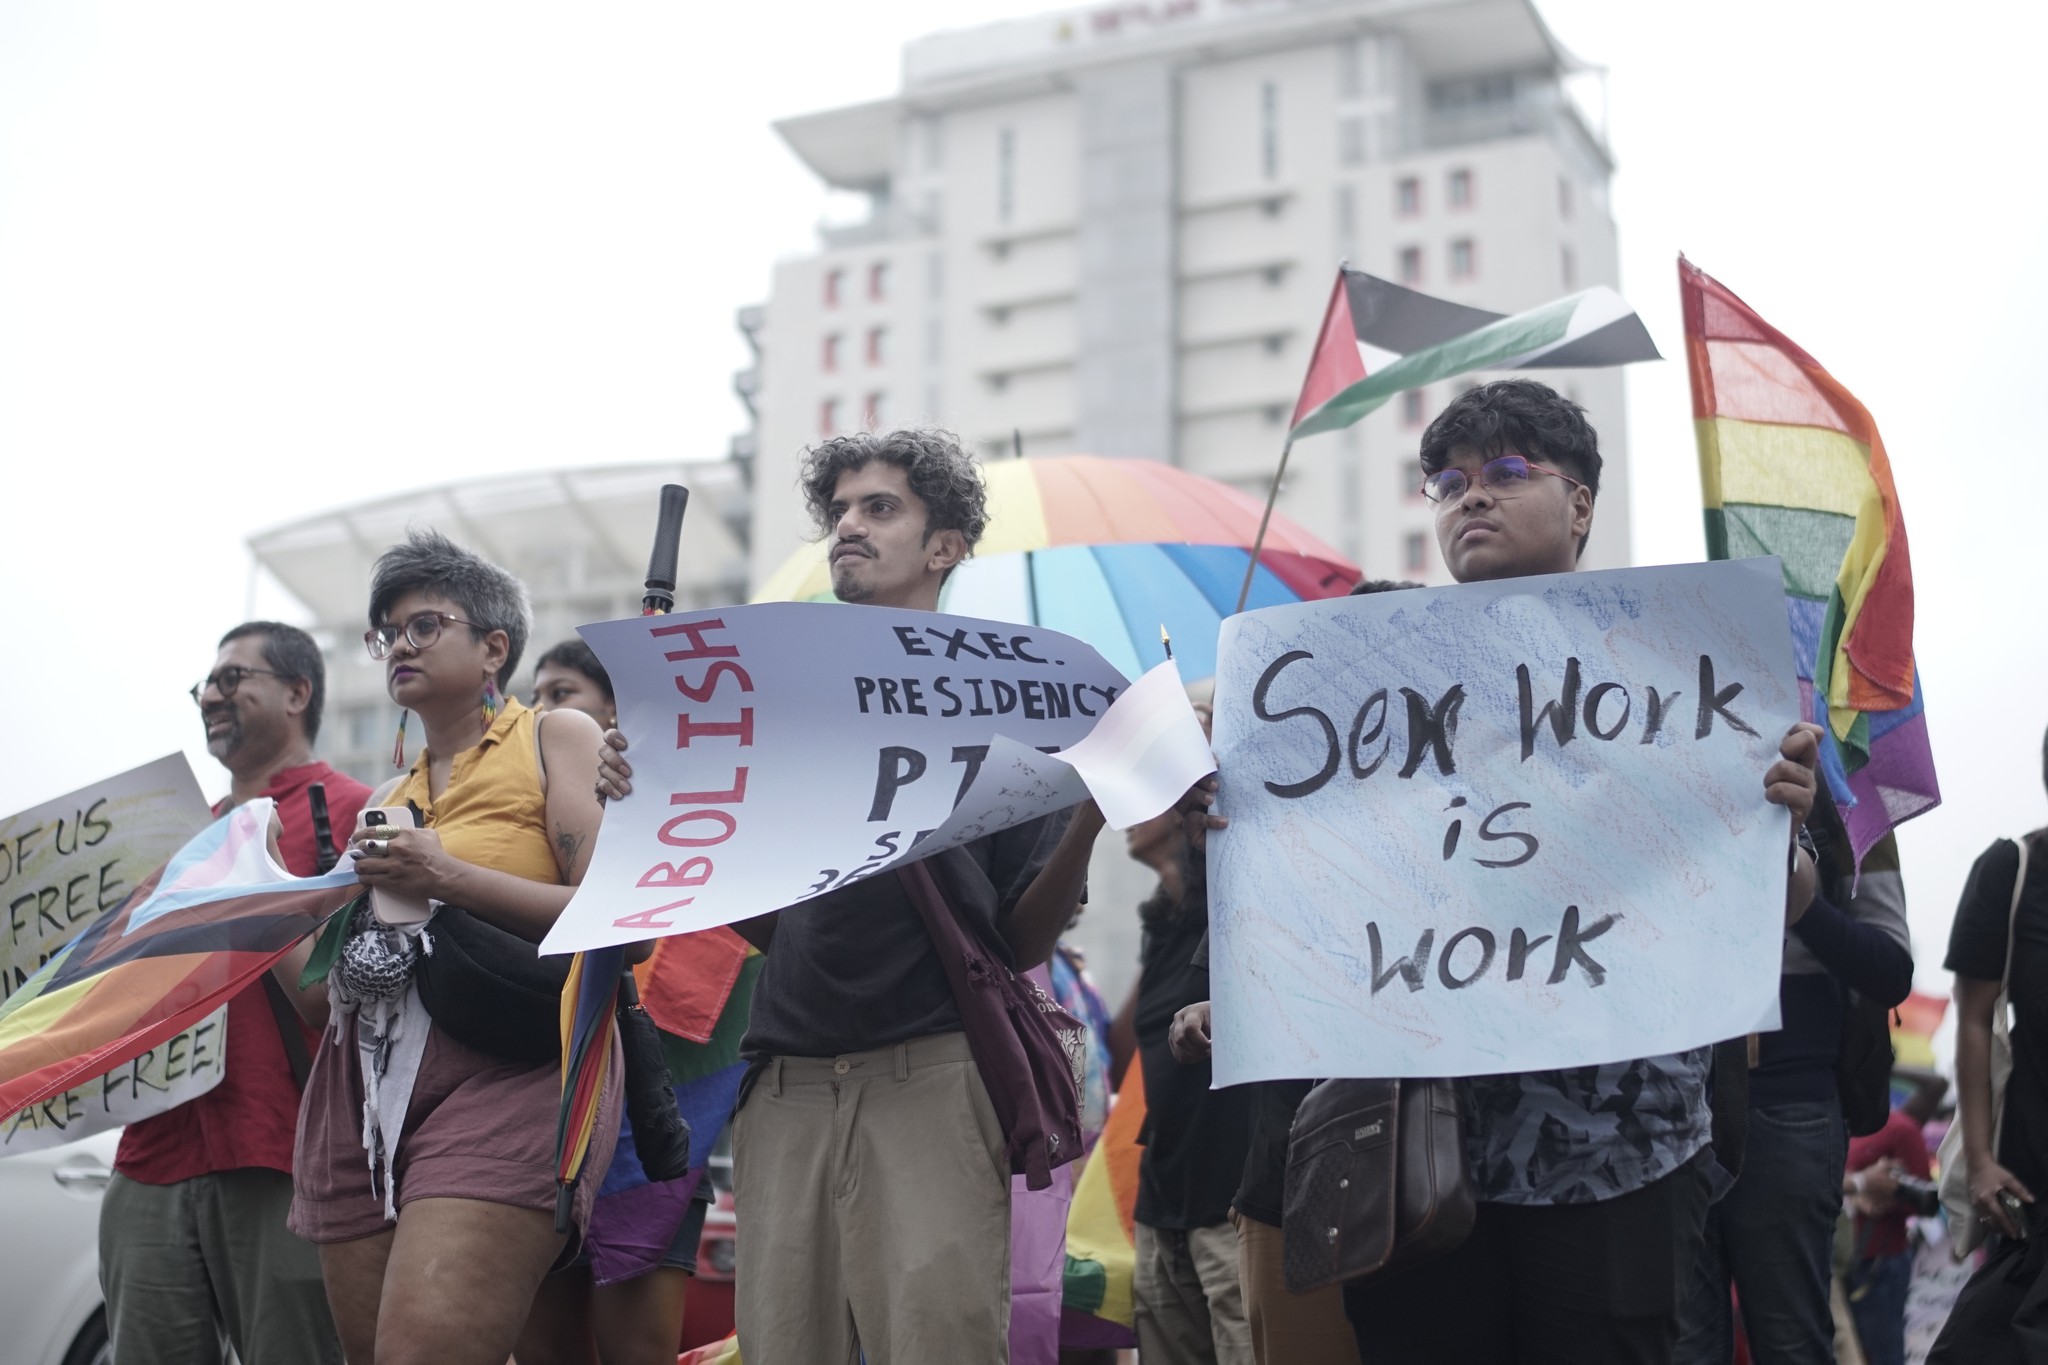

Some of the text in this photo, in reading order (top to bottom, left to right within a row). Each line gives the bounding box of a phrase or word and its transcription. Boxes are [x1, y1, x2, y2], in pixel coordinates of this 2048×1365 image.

[892, 626, 1066, 666] EXEC.
[1253, 650, 1762, 798] Sex Work
[612, 618, 754, 928] ABOLISH
[56, 798, 112, 855] US
[1443, 796, 1539, 868] is
[10, 859, 125, 946] FREE
[5, 1011, 226, 1145] ARE FREE!
